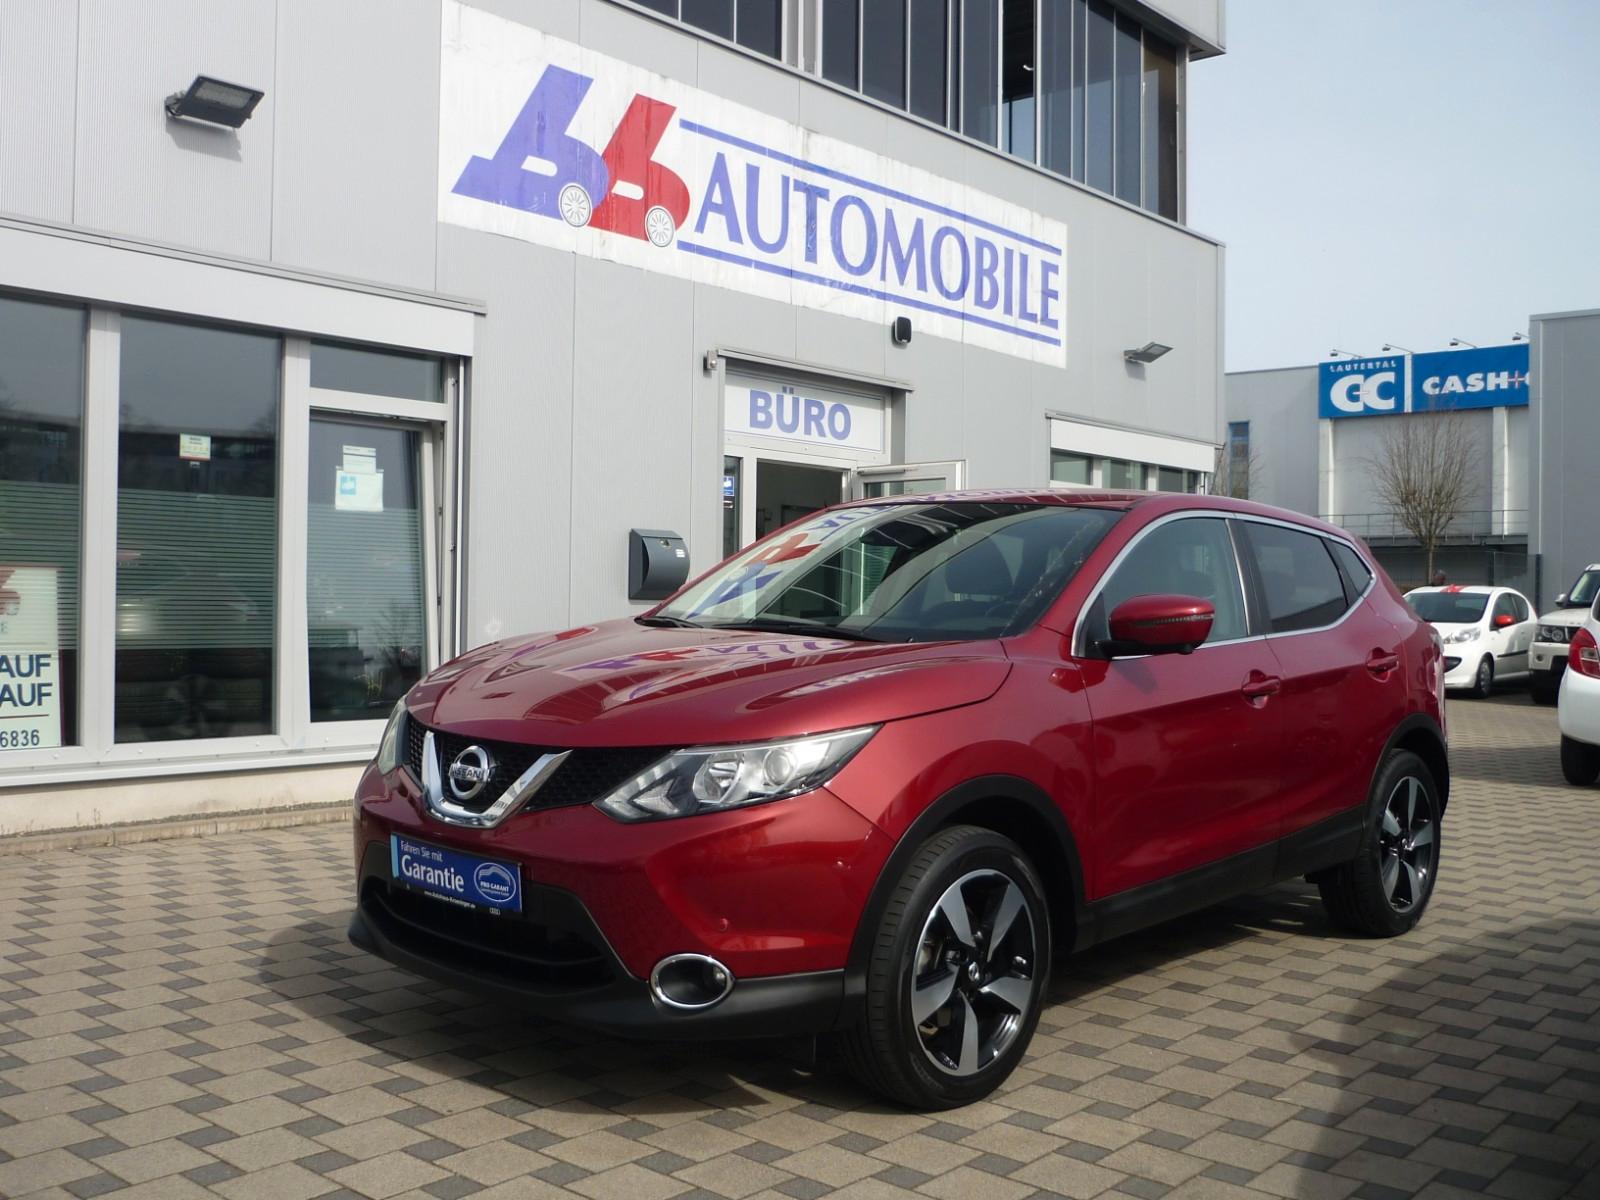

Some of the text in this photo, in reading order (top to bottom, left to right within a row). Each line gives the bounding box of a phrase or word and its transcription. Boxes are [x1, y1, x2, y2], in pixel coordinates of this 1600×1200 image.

[694, 152, 1060, 329] AUTOMOBILE
[1329, 360, 1397, 373] LAUTERTAL
[749, 386, 852, 440] BÜRO
[0, 729, 41, 748] 6836
[400, 840, 420, 855] Fahren
[421, 847, 431, 859] Sie
[401, 855, 464, 892] Garantie
